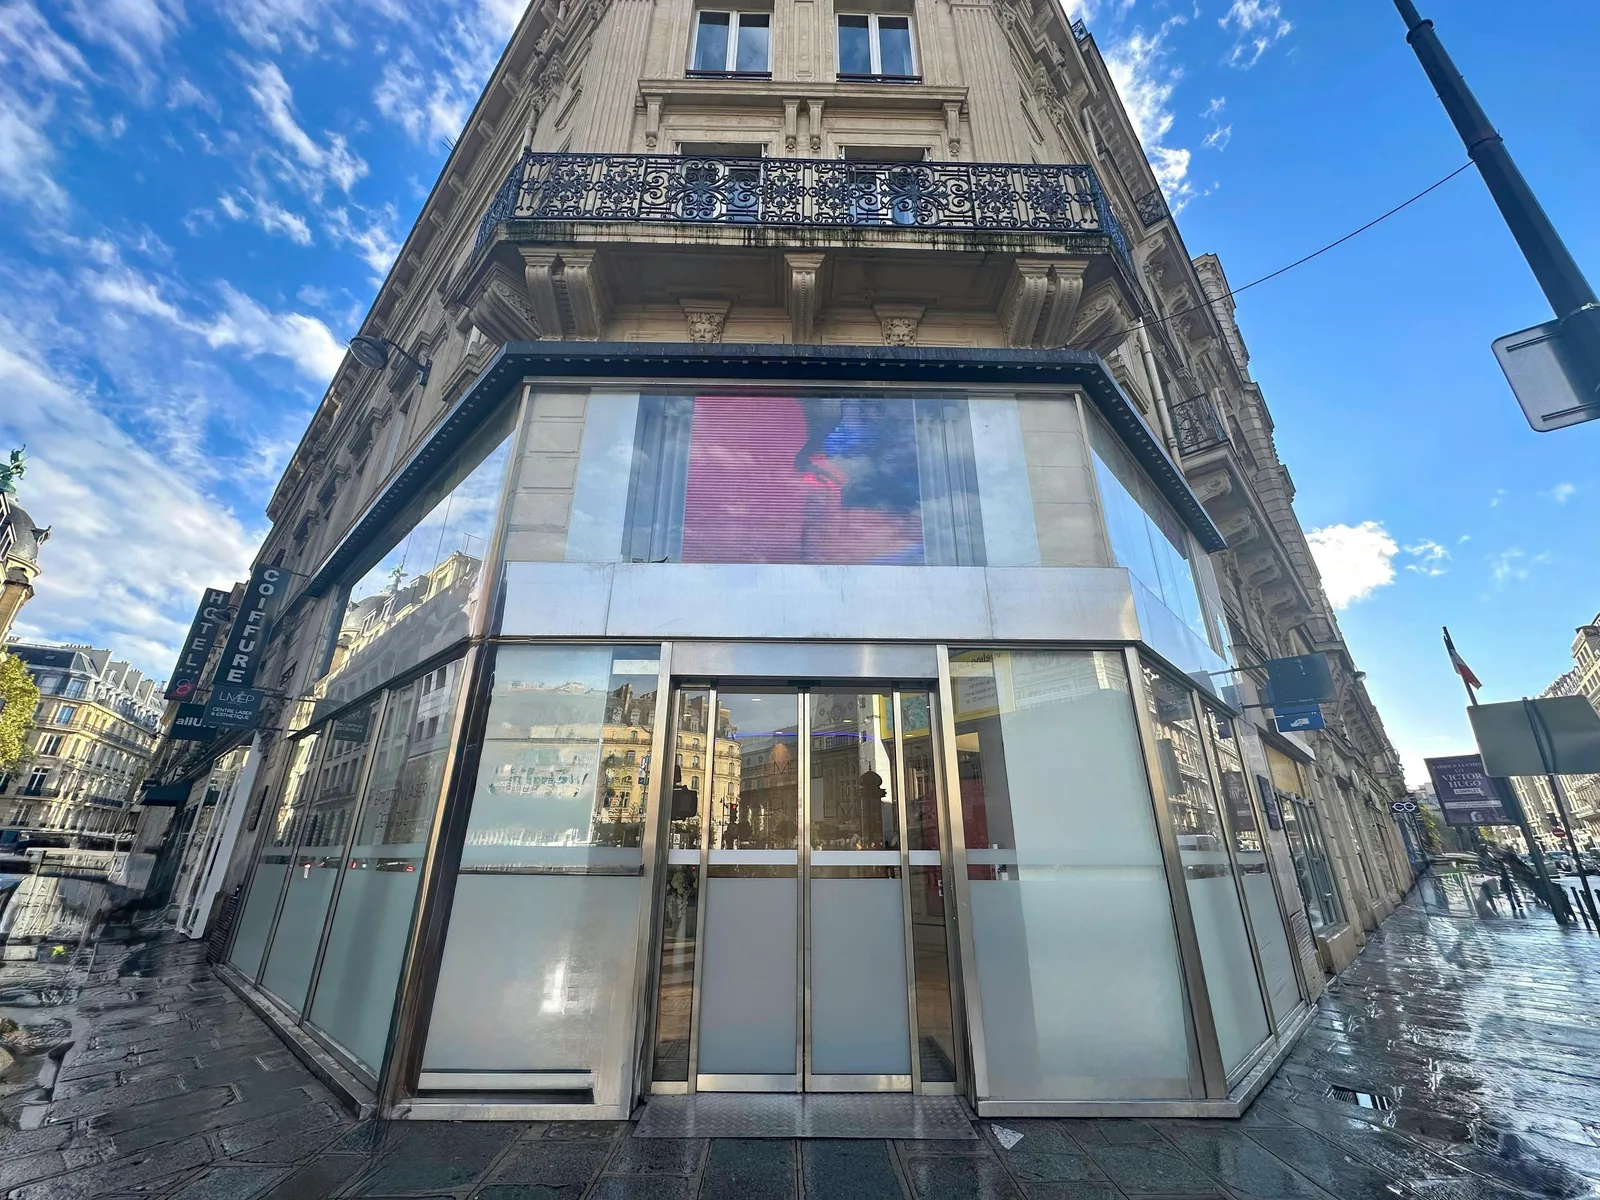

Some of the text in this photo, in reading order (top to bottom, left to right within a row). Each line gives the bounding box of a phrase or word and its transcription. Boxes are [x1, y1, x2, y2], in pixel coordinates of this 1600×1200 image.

[185, 591, 223, 667] HOTEL
[226, 569, 280, 683] COIFFURE
[212, 706, 235, 714] CENTRE
[1441, 772, 1483, 781] VICTOR
[1448, 780, 1482, 788] HUGO
